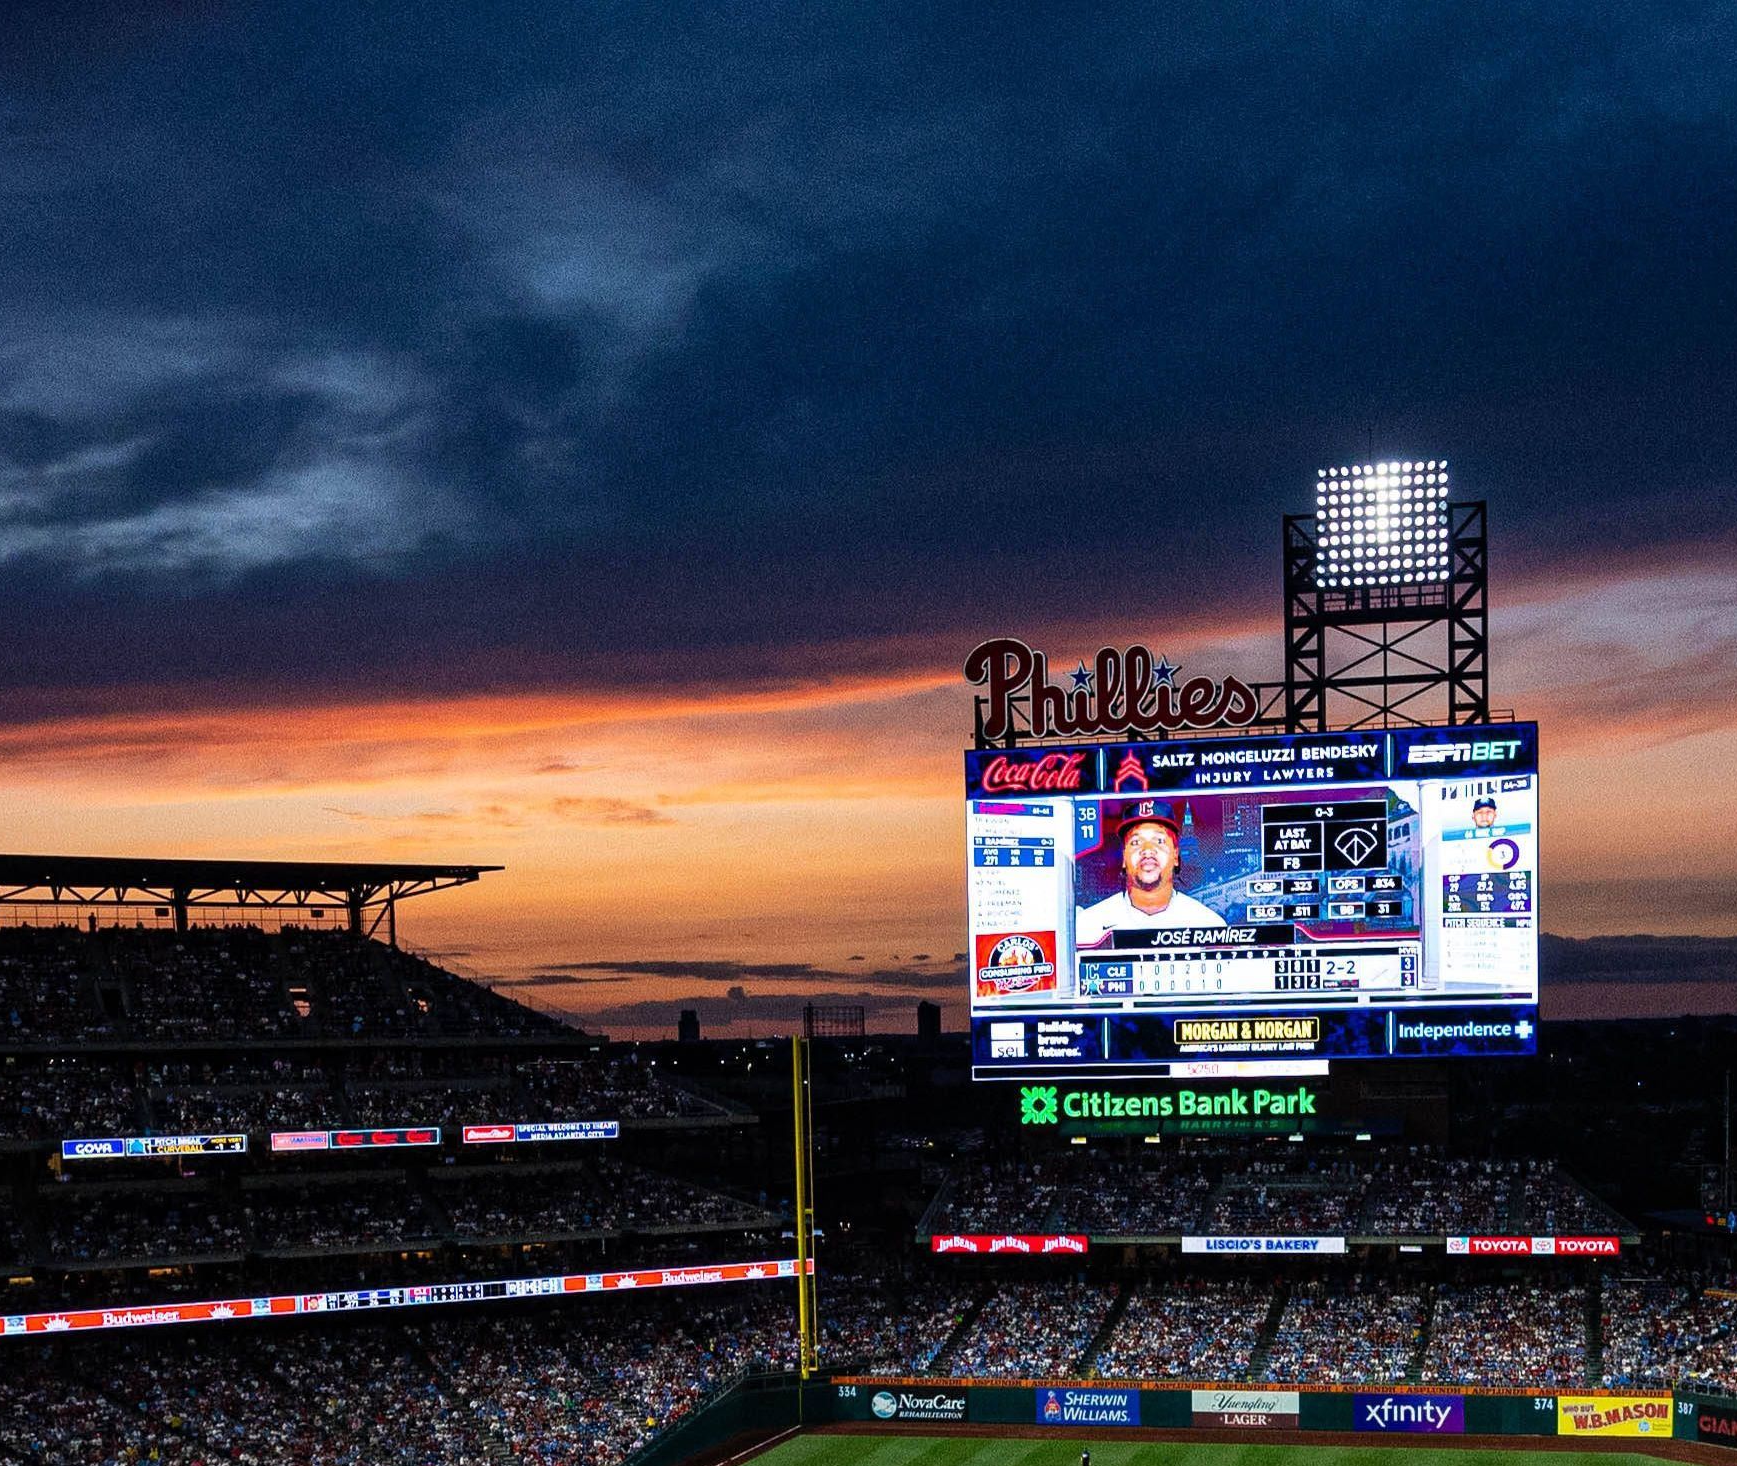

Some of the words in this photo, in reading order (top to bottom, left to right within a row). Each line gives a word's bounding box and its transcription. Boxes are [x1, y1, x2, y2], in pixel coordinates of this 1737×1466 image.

[964, 638, 1258, 739] Phillies
[1152, 753, 1195, 768] SALTZ
[1201, 749, 1295, 765] MONGELUZZI
[1301, 744, 1379, 761] BENDESKY
[1195, 771, 1252, 784] INJURY
[1263, 767, 1334, 781] LAWYERS
[1078, 807, 1097, 821] 3B
[1315, 807, 1334, 818] 0-3
[1081, 825, 1094, 838] 11
[1279, 828, 1306, 838] LAST
[1274, 840, 1289, 850] AT
[1291, 839, 1312, 850] BAT
[1283, 858, 1301, 869] F8
[1290, 881, 1313, 892] .323
[1377, 903, 1390, 914] 31
[1151, 927, 1191, 946] JOSÉ
[1193, 926, 1257, 945] RAMÍREZ
[1106, 966, 1127, 977] CLE
[1326, 960, 1355, 975] 2-2
[1107, 982, 1126, 993] PHI
[1181, 1022, 1238, 1041] MORGAN
[1241, 1021, 1252, 1039] &
[1254, 1020, 1314, 1039] MORGAN
[1399, 1023, 1512, 1041] Independence
[1063, 1089, 1174, 1118] Citizens
[1179, 1088, 1249, 1116] Bank
[1253, 1086, 1317, 1115] Park
[1181, 1120, 1232, 1129] HARRY
[75, 1143, 113, 1155] GOYA
[156, 1145, 204, 1153] CURVEBALL
[953, 1236, 977, 1251] BEAM
[1005, 1236, 1030, 1251] BEAM
[1059, 1236, 1083, 1251] BEAM
[1206, 1238, 1262, 1250] LISCIO'S
[1265, 1238, 1319, 1250] BAKERY
[1472, 1240, 1529, 1253] TOYOTA
[1558, 1240, 1615, 1253] TOYOTA
[661, 1270, 723, 1283] Budweiser
[102, 1310, 180, 1326] Budweiser
[854, 1378, 903, 1386] ASPLUNDH
[912, 1378, 962, 1387] ASPLUNDH
[972, 1379, 1022, 1387] ASPLUNDH
[1030, 1380, 1082, 1388] ASPLUNDH
[1091, 1381, 1143, 1389] ASPLUNDH
[1153, 1382, 1205, 1390] ASPLUNDH
[1215, 1383, 1268, 1391] ASPLUNDH
[1278, 1384, 1332, 1392] ASPLUNDH
[838, 1386, 856, 1398] 334
[1472, 1387, 1528, 1395] ASPLUNDH
[1538, 1388, 1594, 1396] ASPLUNDH
[1609, 1389, 1664, 1397] ASPLUNDH
[899, 1393, 965, 1410] NovaCare
[1065, 1391, 1127, 1407] SHERWIN
[1212, 1391, 1278, 1412] Yuengling
[1533, 1398, 1553, 1411] 374
[899, 1410, 963, 1419] REHABILITATION
[1366, 1398, 1452, 1428] xfinity
[1562, 1405, 1579, 1414] WHO
[1678, 1402, 1694, 1415] 387
[1224, 1414, 1267, 1426] LAGER
